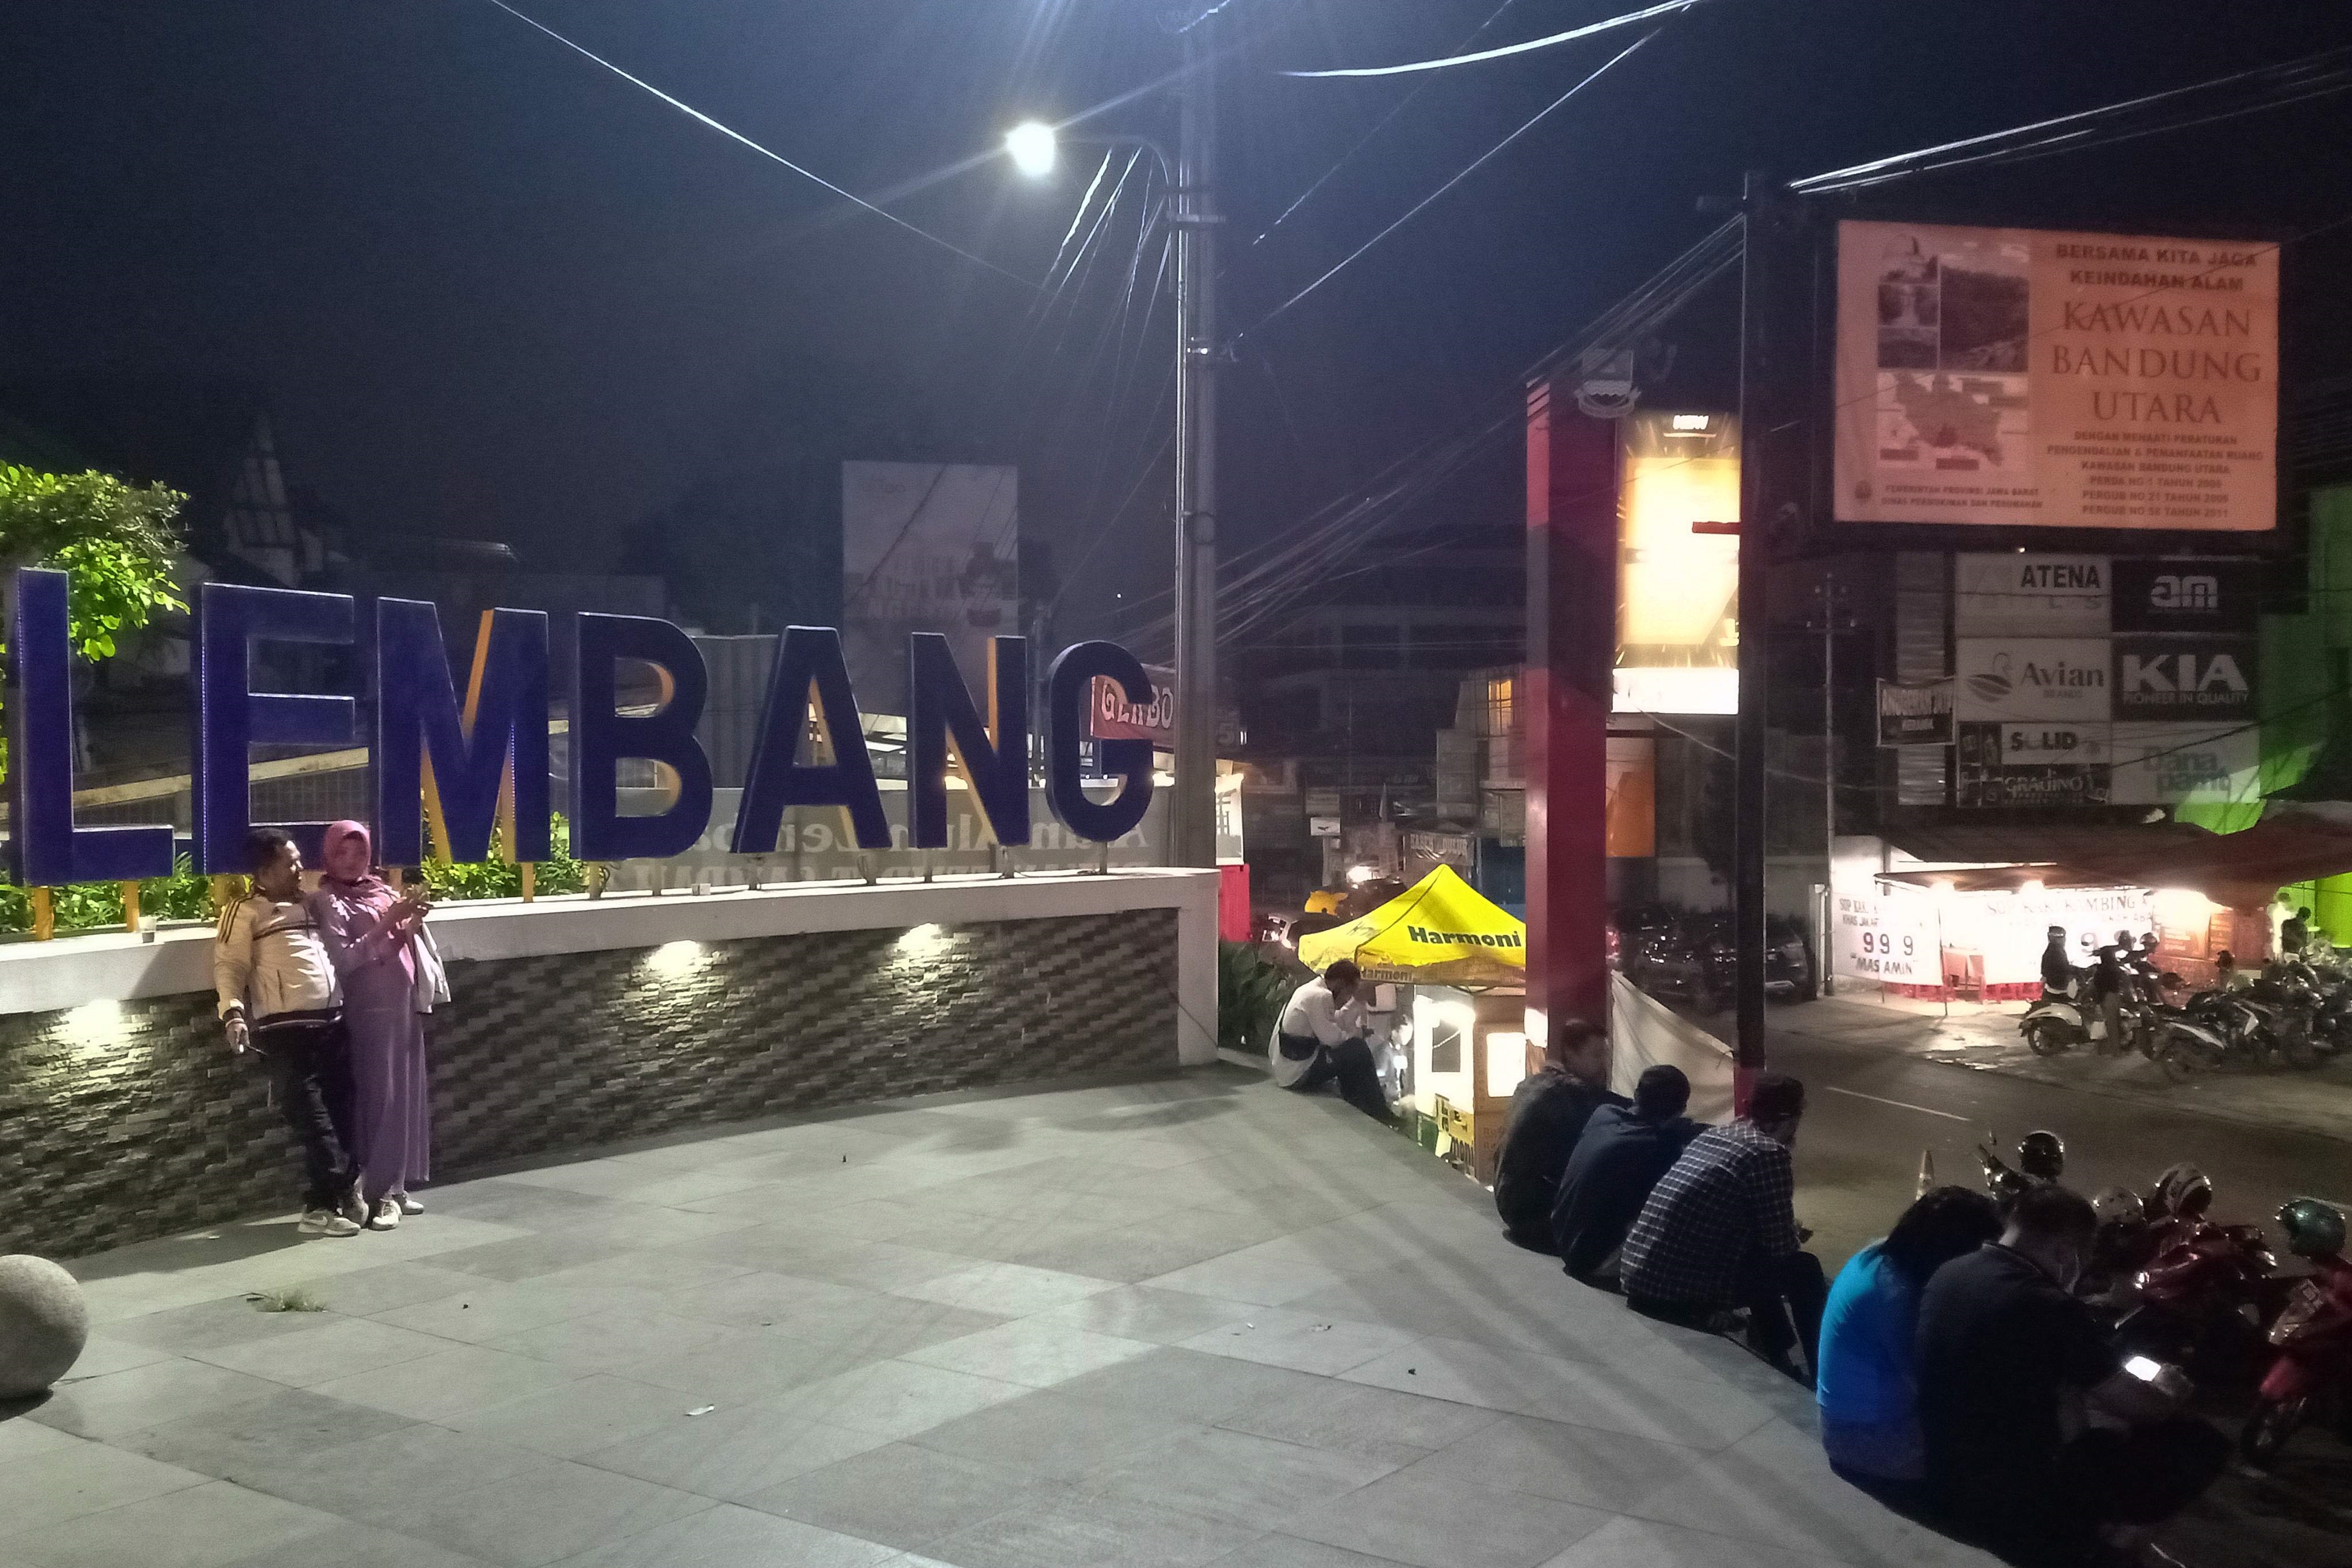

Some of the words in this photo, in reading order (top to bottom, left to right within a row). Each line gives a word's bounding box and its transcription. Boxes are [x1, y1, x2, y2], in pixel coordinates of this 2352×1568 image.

[2056, 243, 2149, 262] BERSAMA
[2157, 249, 2200, 265] KITA
[2207, 251, 2257, 266] JAGA
[2069, 270, 2185, 288] KEINDAHAN
[2191, 277, 2243, 291] ALAM
[2063, 299, 2252, 338] KAWASAN
[2051, 344, 2262, 383] BANDUNG
[2091, 390, 2223, 425] UTARA
[2074, 431, 2119, 441] DENGAN
[2081, 461, 2135, 471] KAWASAN
[2138, 462, 2192, 473] BANDUNG
[2020, 564, 2100, 589] ATENA
[2018, 660, 2105, 690] Avian
[2122, 655, 2249, 691] KIA
[2123, 692, 2176, 704] PIONEER
[2180, 692, 2194, 704] IN
[2196, 692, 2249, 704] QUALITY
[9, 567, 1155, 886] LEMBANG
[1407, 924, 1522, 948] Harmoni
